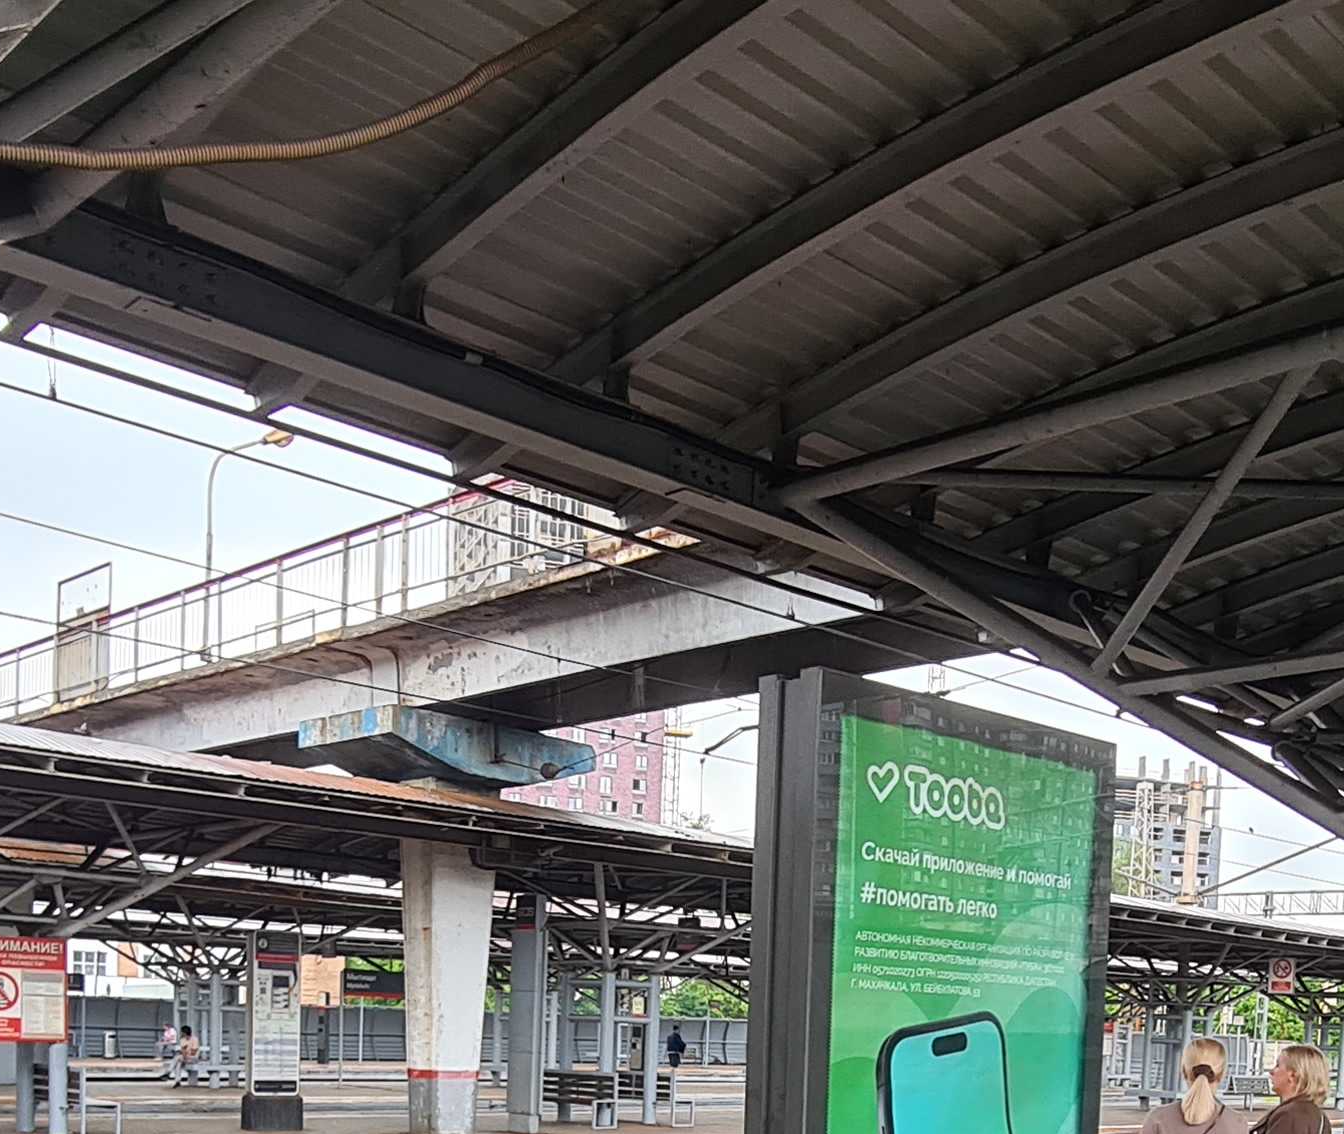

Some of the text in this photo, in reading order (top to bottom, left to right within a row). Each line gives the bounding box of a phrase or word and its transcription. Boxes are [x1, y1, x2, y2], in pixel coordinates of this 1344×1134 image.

[861, 841, 1071, 890] Скачай приложение и помогай
[860, 881, 998, 918] #помогать легко
